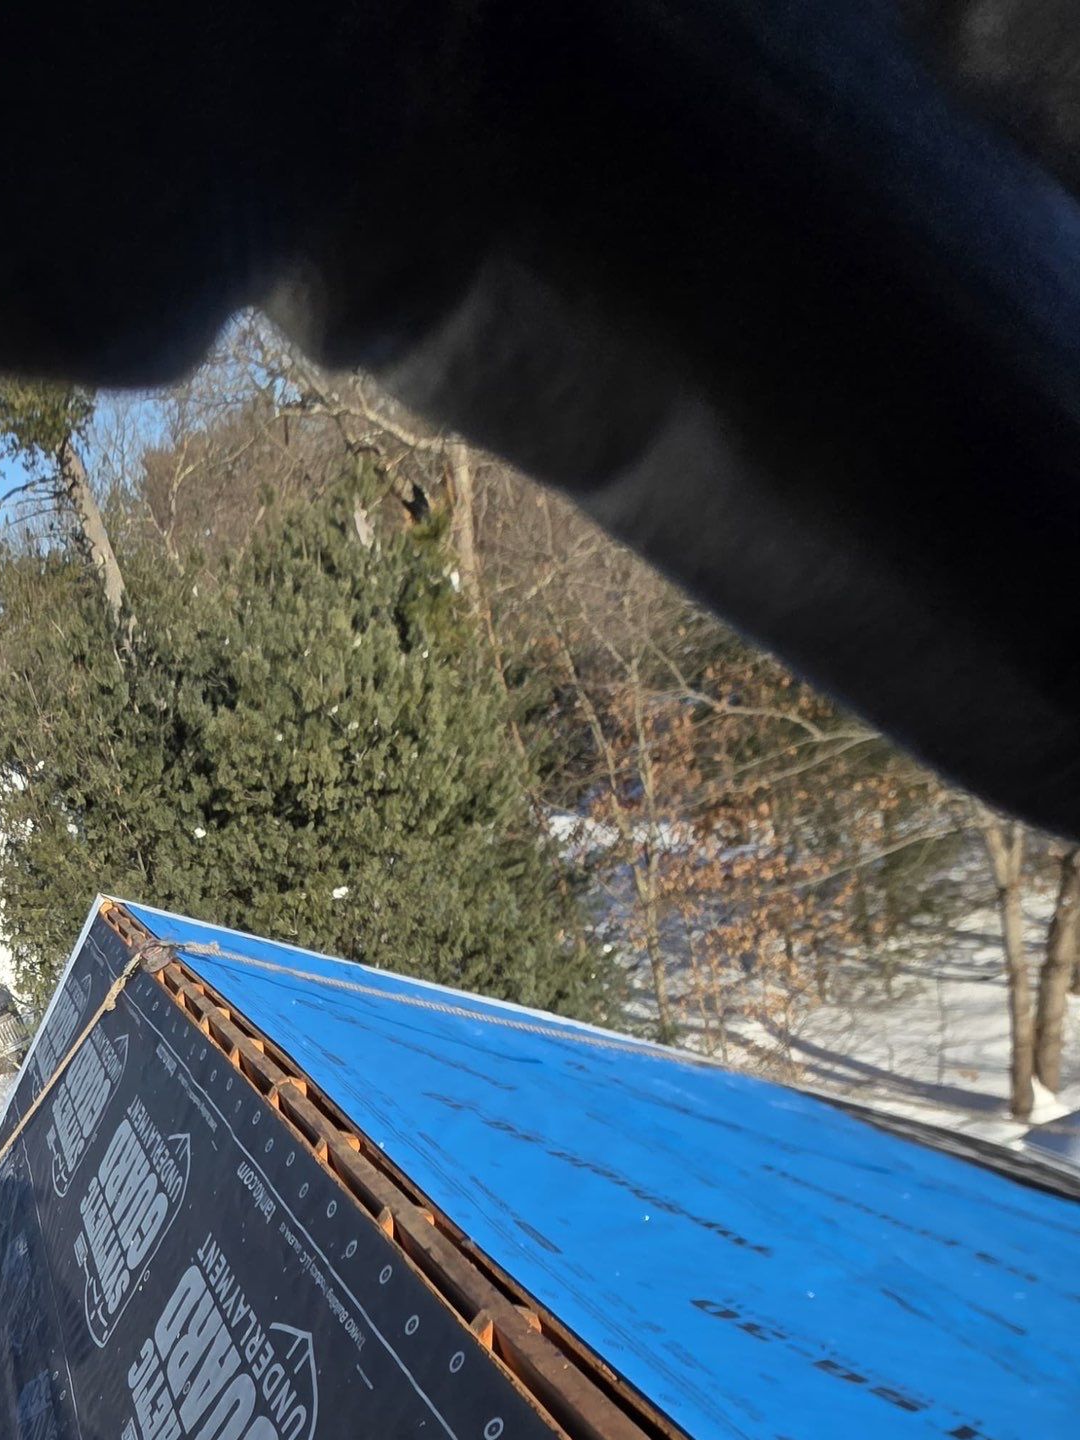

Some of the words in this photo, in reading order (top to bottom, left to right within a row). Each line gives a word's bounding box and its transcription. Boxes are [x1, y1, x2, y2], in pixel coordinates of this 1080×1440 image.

[98, 1118, 168, 1270] GUARD
[127, 1094, 182, 1202] UNDERLAYMENT
[237, 1160, 276, 1224] tamko.com
[80, 1176, 130, 1314] SYNTHETIC
[344, 1318, 366, 1351] TAMKO
